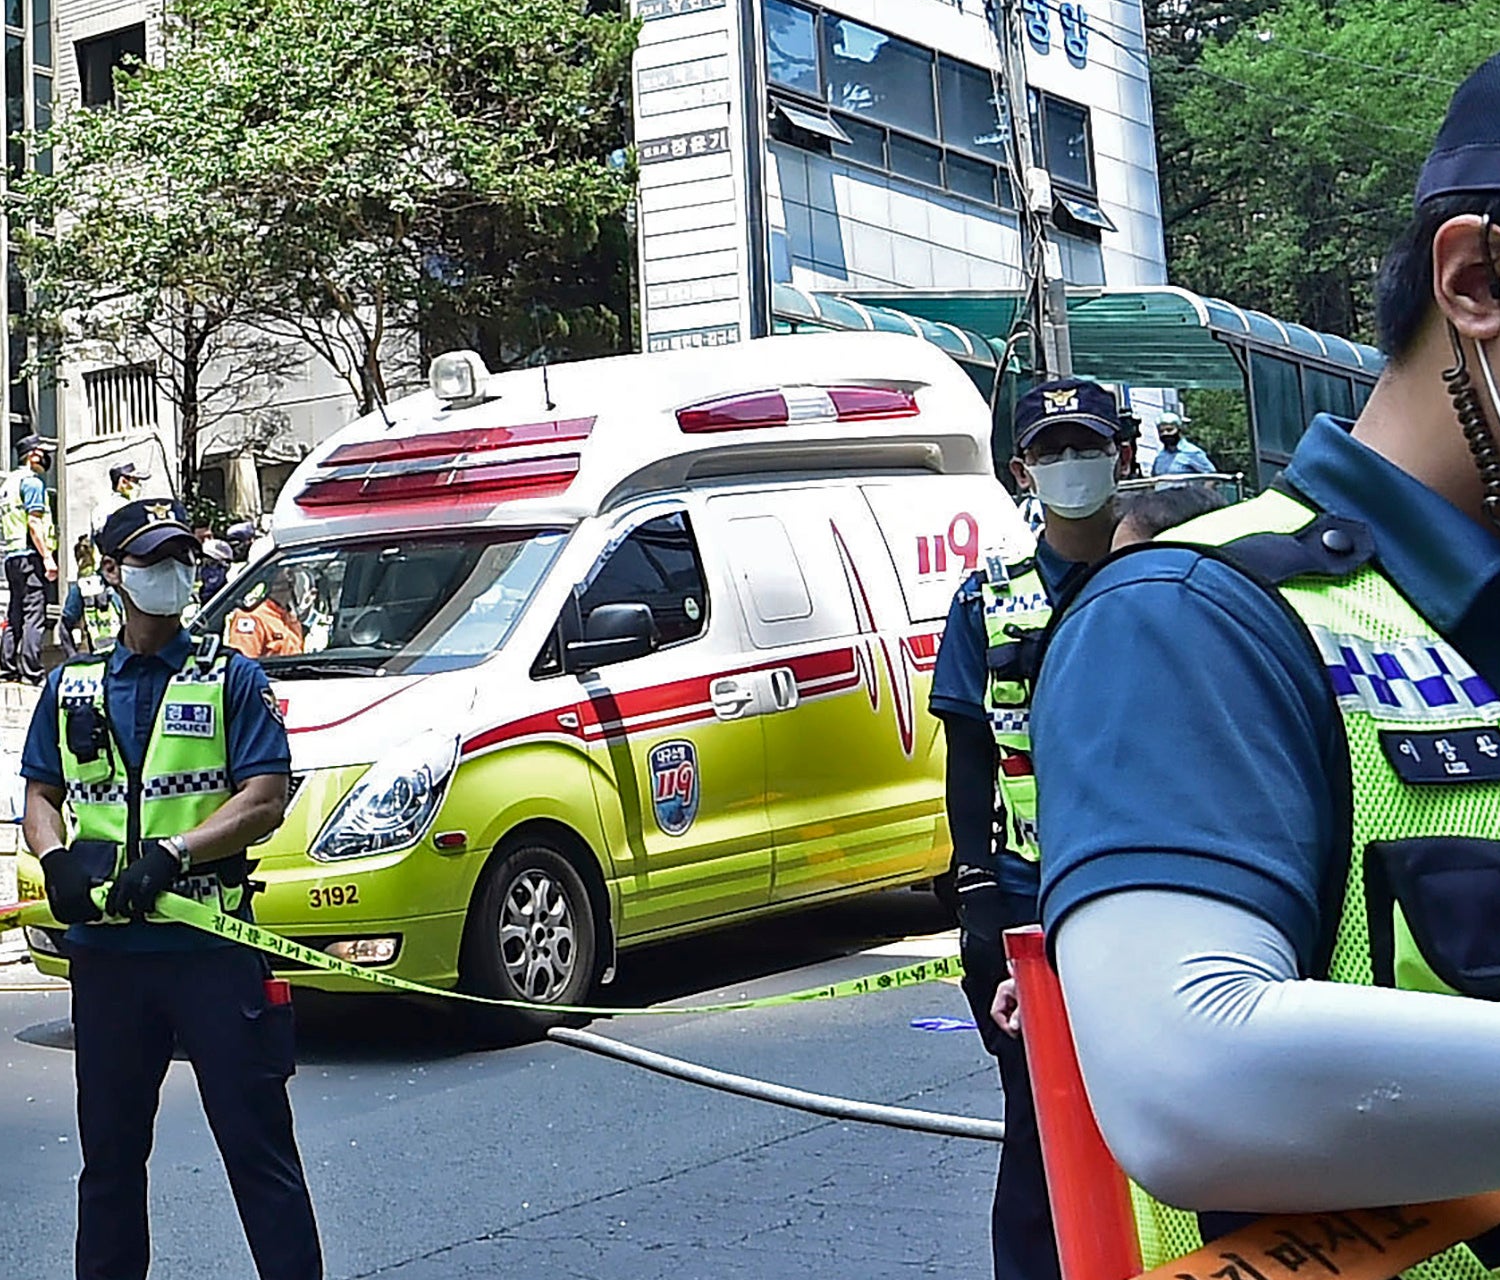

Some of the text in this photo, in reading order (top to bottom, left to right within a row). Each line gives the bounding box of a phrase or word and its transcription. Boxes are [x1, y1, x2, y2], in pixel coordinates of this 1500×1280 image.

[916, 511, 979, 575] 119
[166, 723, 208, 733] POLICE
[656, 761, 694, 807] 119
[309, 885, 359, 909] 3192
